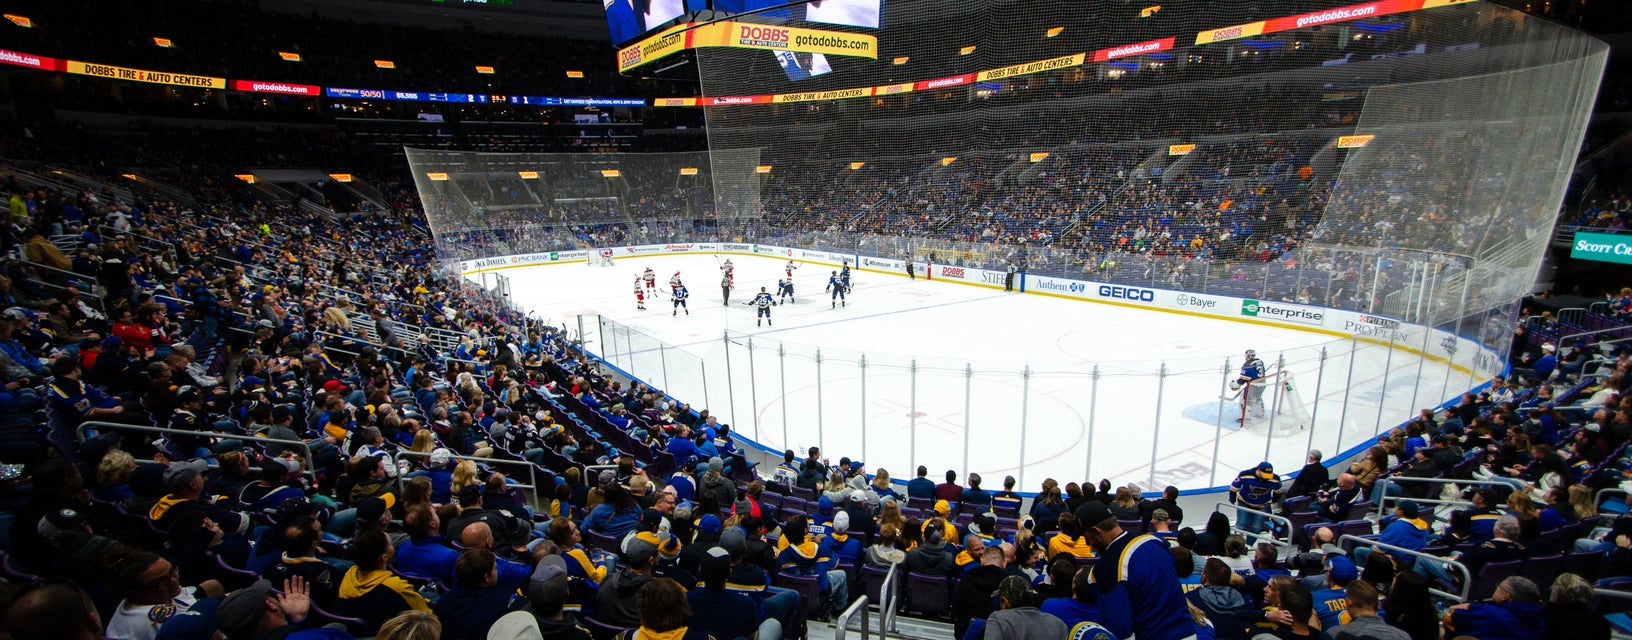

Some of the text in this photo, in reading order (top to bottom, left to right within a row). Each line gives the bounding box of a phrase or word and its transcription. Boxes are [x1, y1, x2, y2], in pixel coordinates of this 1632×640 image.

[1296, 5, 1375, 28] gotodobbs.com
[741, 26, 790, 42] DOBBS
[1213, 27, 1242, 38] DOBBS
[643, 34, 680, 58] gotodobbs.com
[796, 34, 869, 50] gotodobbs.com
[622, 46, 640, 62] DOBBS
[1108, 42, 1160, 58] gotodobbs.com
[986, 68, 1006, 79] DOBBS
[1006, 66, 1020, 76] TIRE
[1026, 62, 1043, 73] AUTO
[1044, 56, 1074, 69] CENTERS
[84, 64, 212, 86] DOBBS TIRE & AUTO CENTERS
[928, 76, 964, 88] gotodobbs.com
[253, 82, 308, 94] gotodobbs.com
[360, 90, 381, 98] 50/50
[782, 93, 802, 102] DOBBS
[803, 92, 816, 100] TIRE
[822, 91, 838, 99] AUTO
[838, 88, 863, 98] CENTERS
[468, 94, 474, 102] 2
[523, 96, 529, 104] 1
[714, 97, 752, 105] gdobbs.com
[1576, 240, 1632, 256] SCOTT CR
[474, 260, 486, 268] JACK
[942, 266, 964, 276] DOBBS
[982, 270, 1007, 285] STIFE
[676, 290, 683, 298] 17
[1099, 285, 1154, 302] GEICO
[1190, 296, 1216, 309] Bayer
[1246, 302, 1323, 321] enterprise
[1344, 320, 1409, 342] PRO PLAN
[809, 525, 826, 534] STEEN
